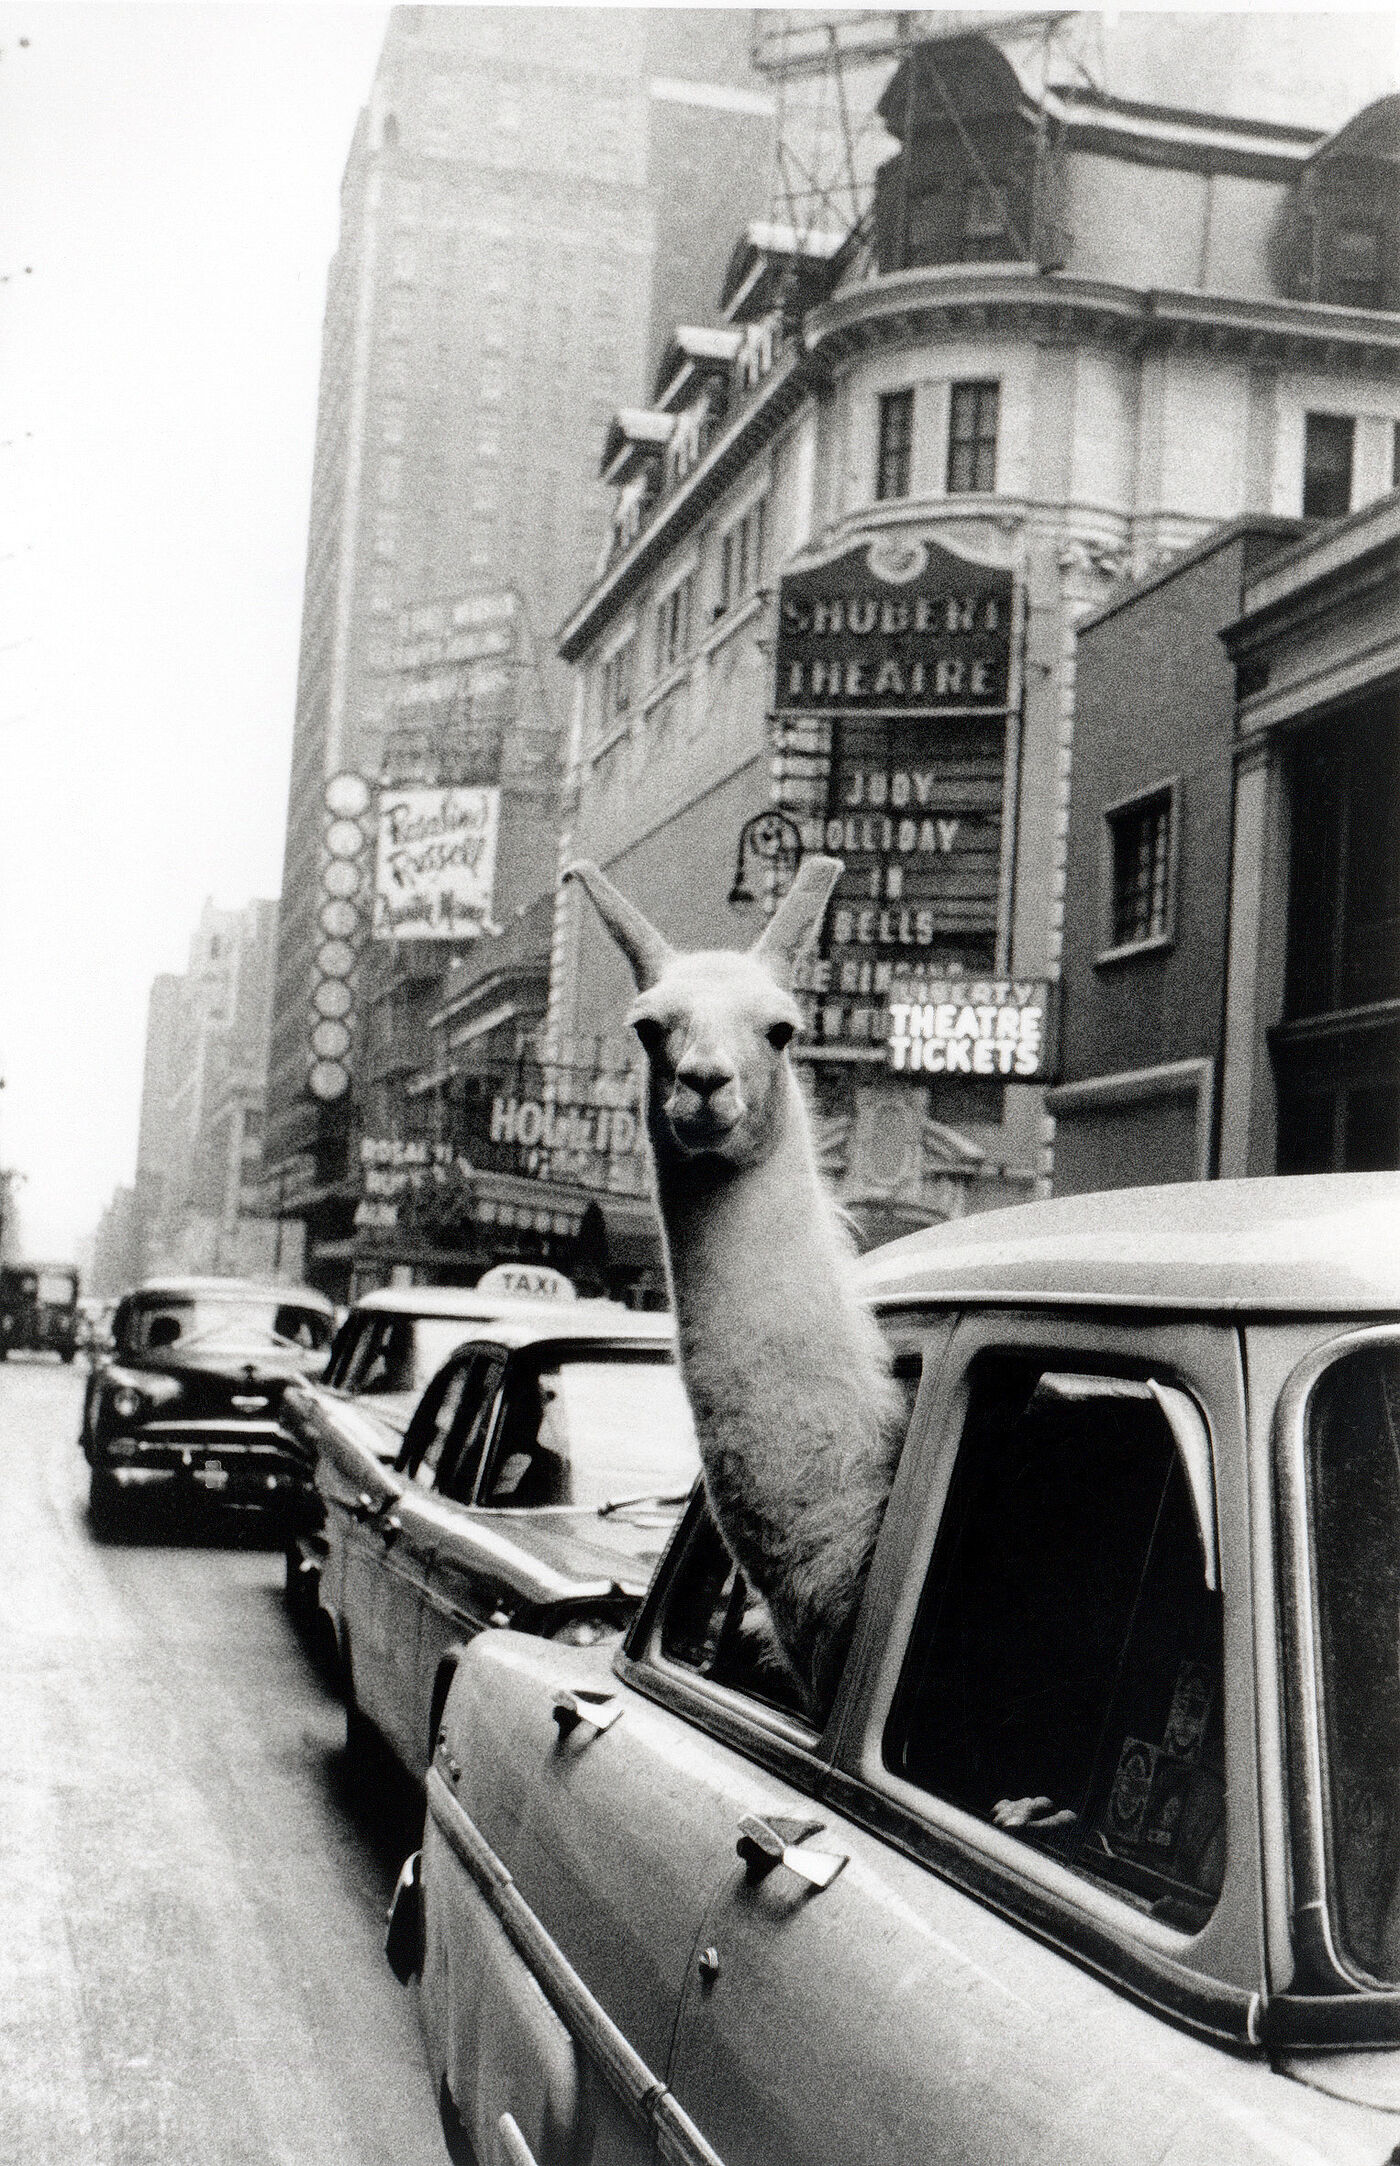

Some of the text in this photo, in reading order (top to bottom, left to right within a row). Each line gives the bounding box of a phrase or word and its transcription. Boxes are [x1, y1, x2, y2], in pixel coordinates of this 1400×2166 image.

[834, 910, 933, 945] BELLS
[889, 1003, 1043, 1040] THEATRE
[888, 1037, 1041, 1075] TICKETS
[502, 1272, 559, 1294] TAXI
